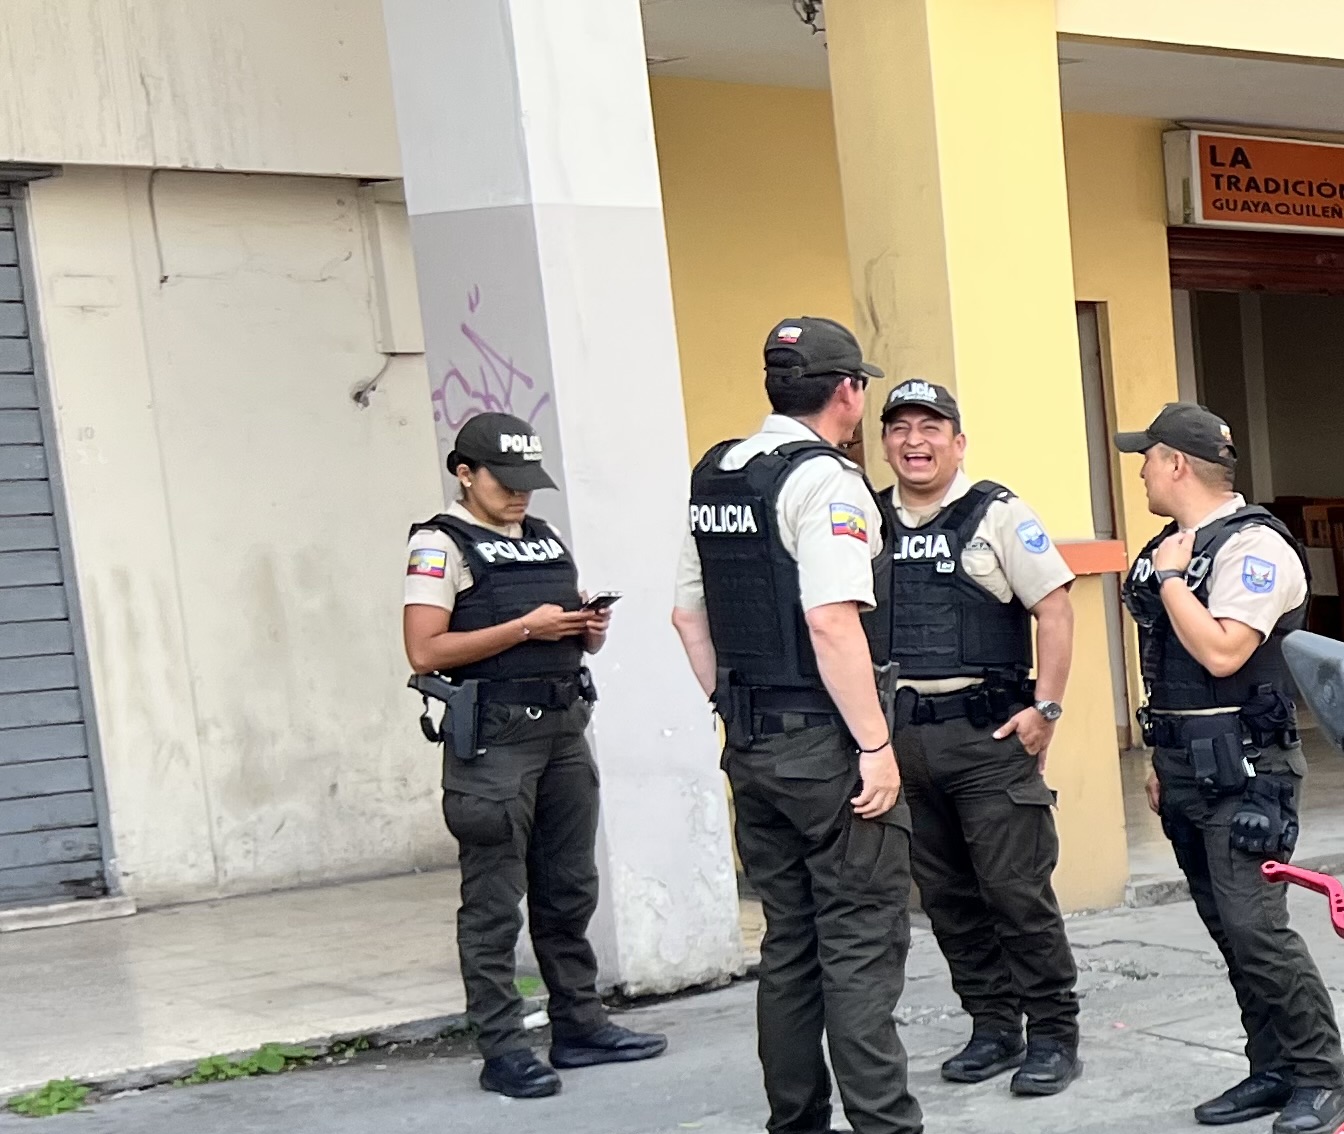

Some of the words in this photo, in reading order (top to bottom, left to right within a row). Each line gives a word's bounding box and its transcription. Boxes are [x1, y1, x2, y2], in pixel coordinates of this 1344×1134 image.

[1209, 145, 1252, 169] LA
[690, 504, 757, 534] POLICIA
[476, 538, 565, 563] POLICIA
[893, 534, 951, 560] ICIA
